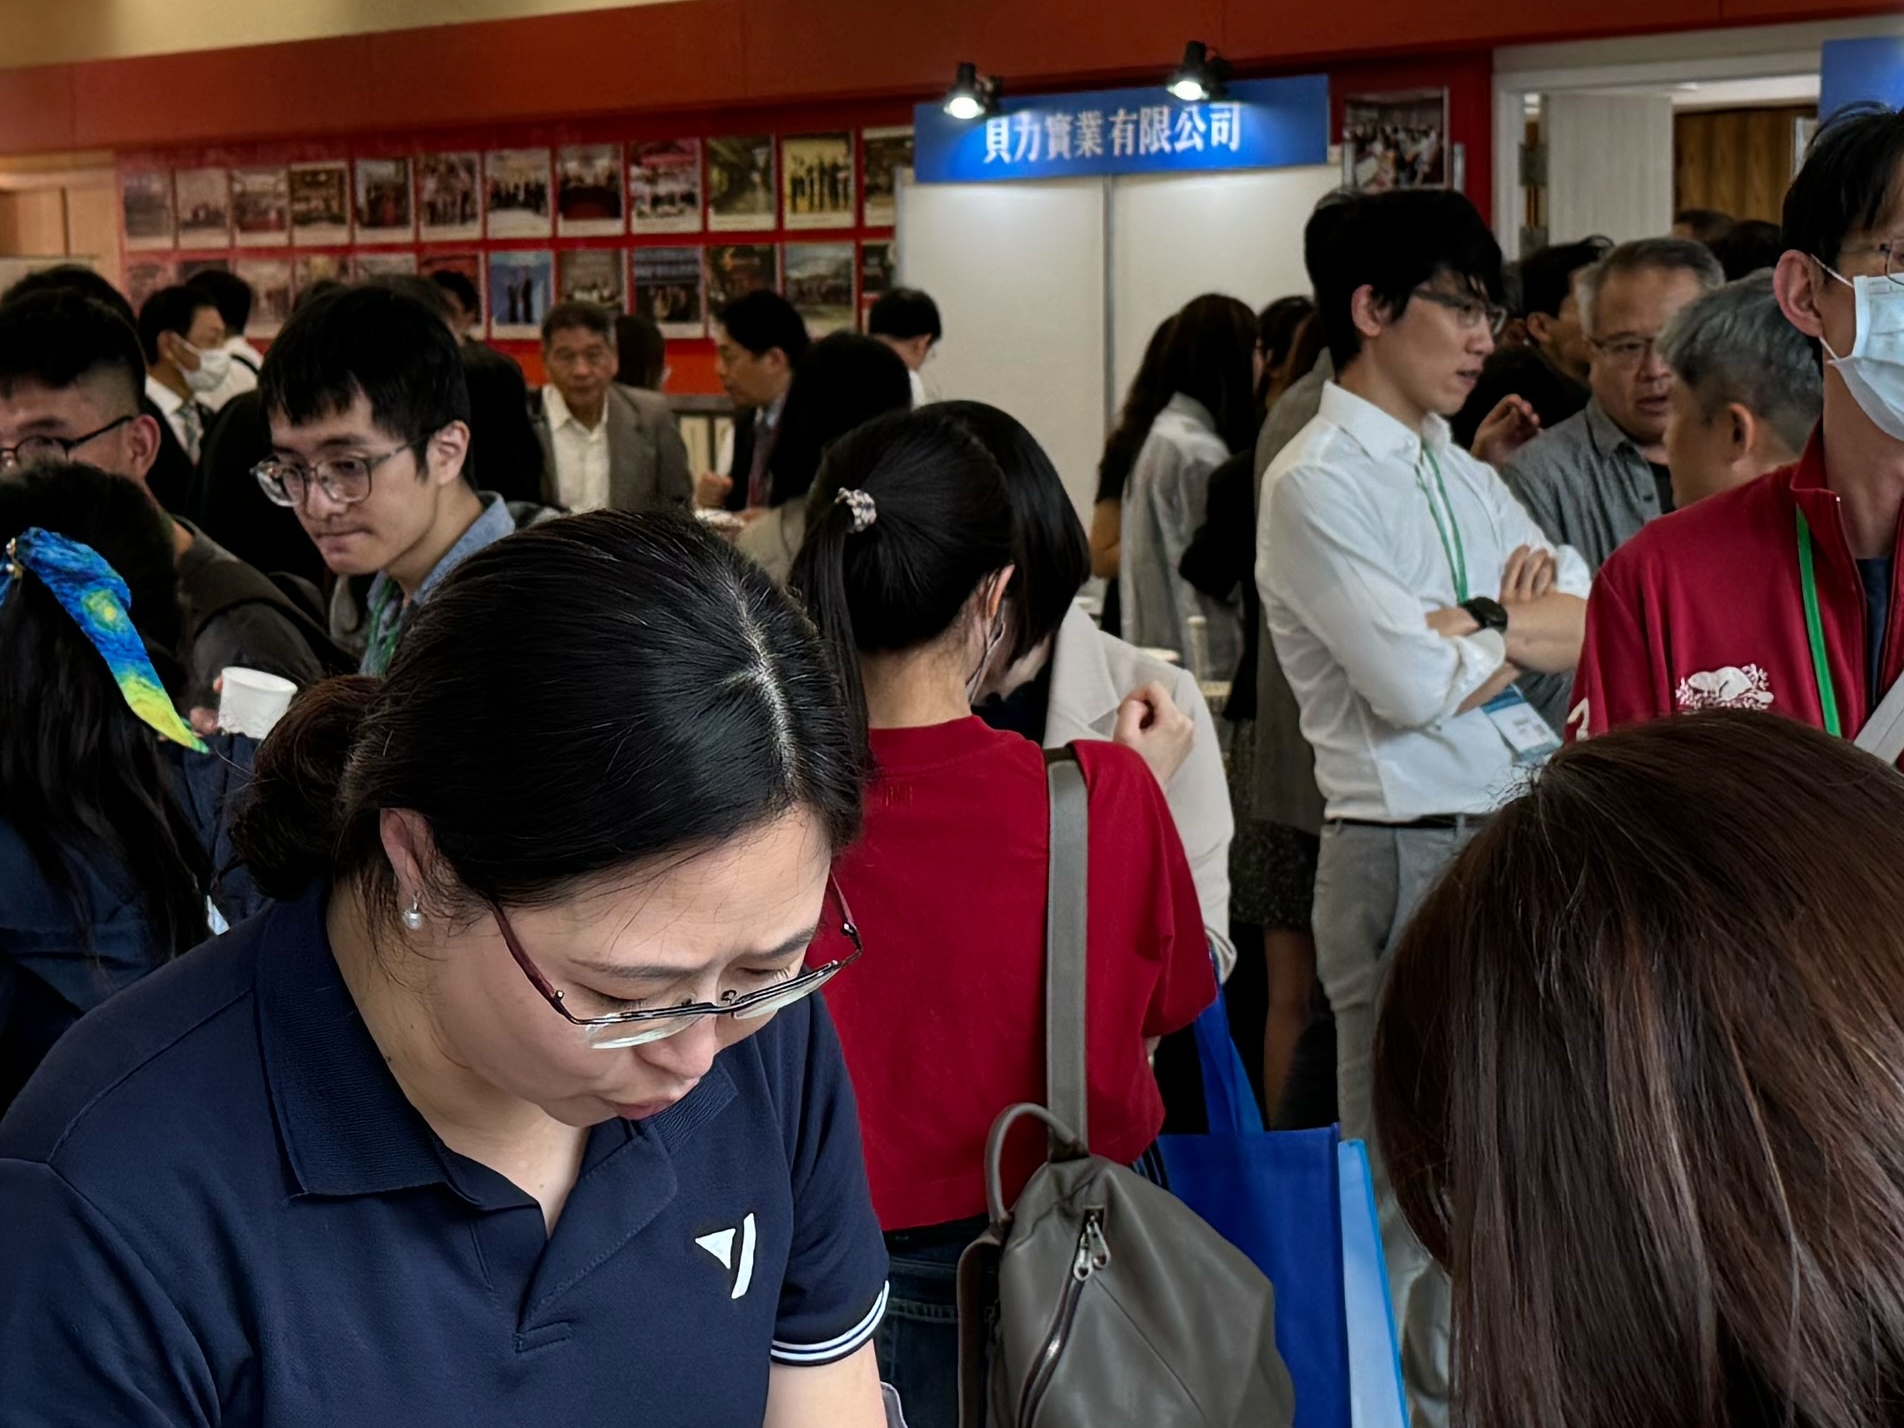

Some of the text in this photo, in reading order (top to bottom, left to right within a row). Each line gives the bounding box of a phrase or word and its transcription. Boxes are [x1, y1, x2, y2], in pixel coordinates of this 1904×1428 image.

[983, 101, 1243, 164] 貝力實業有限公司
